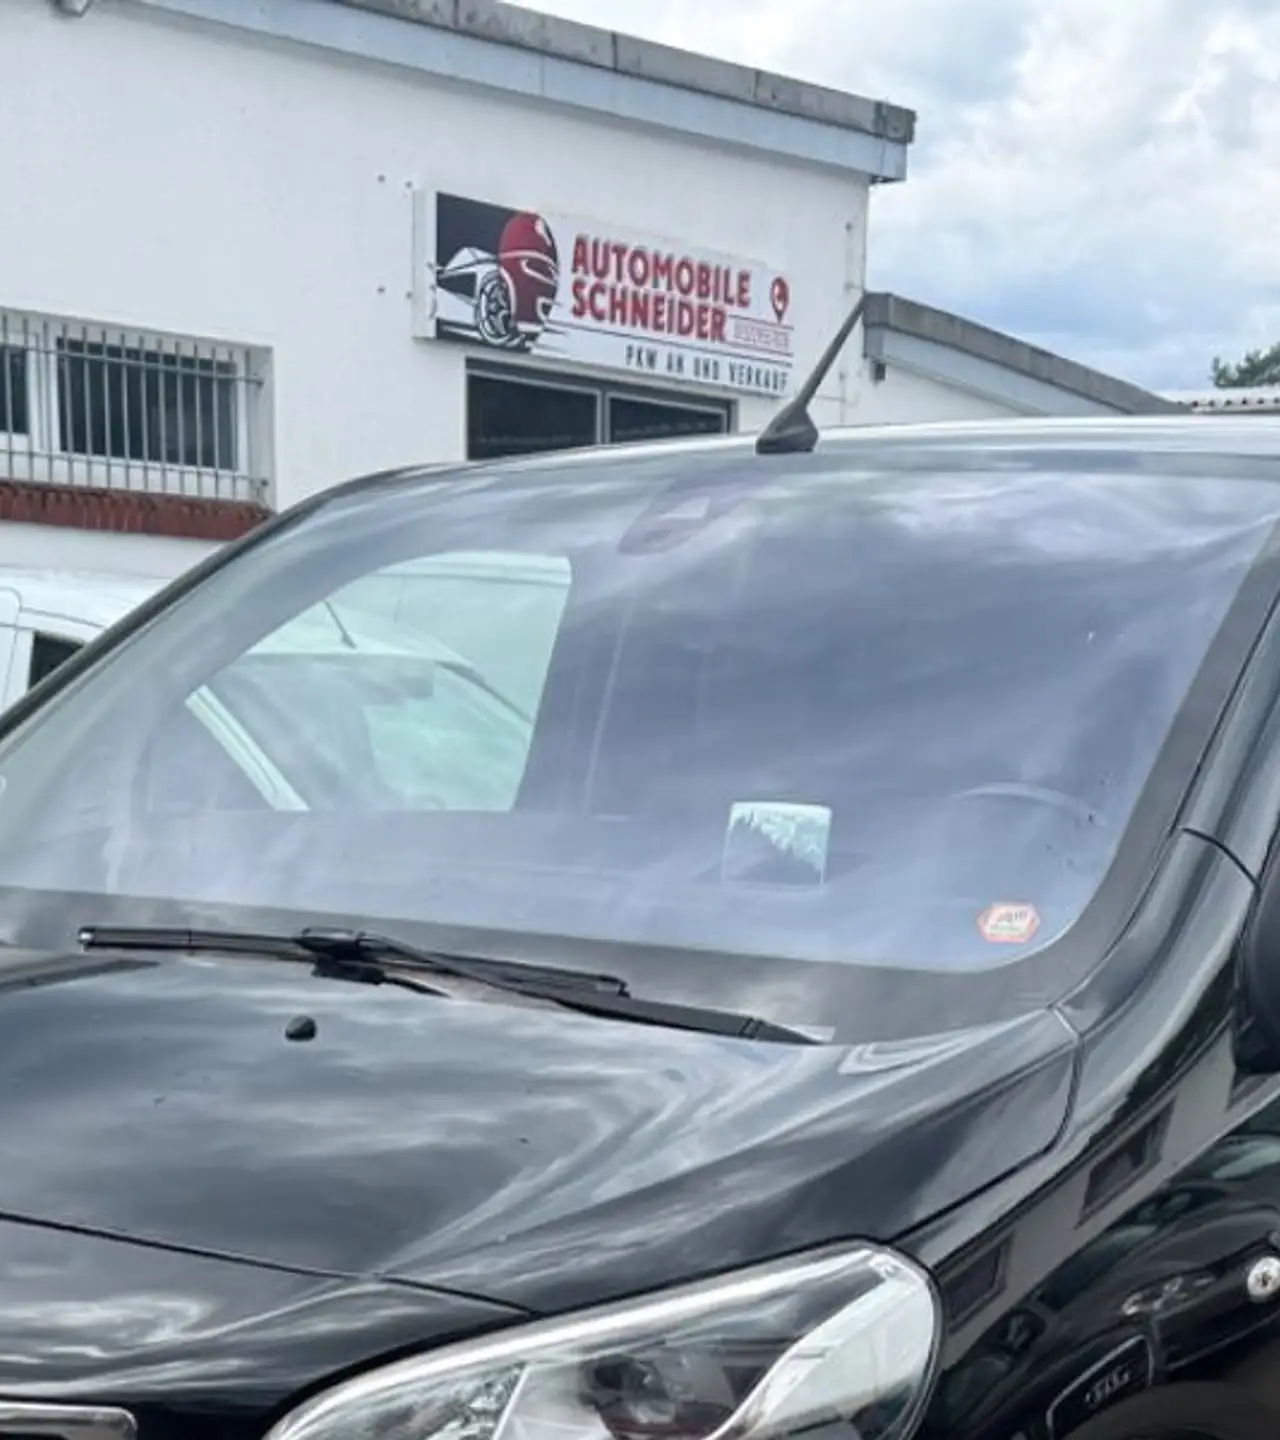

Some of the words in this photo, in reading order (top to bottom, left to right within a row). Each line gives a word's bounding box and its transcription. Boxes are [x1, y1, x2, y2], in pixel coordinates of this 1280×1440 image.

[571, 234, 752, 308] AUTOMOBILE
[570, 281, 728, 342] SCHNEIDER
[625, 344, 657, 369] PKW
